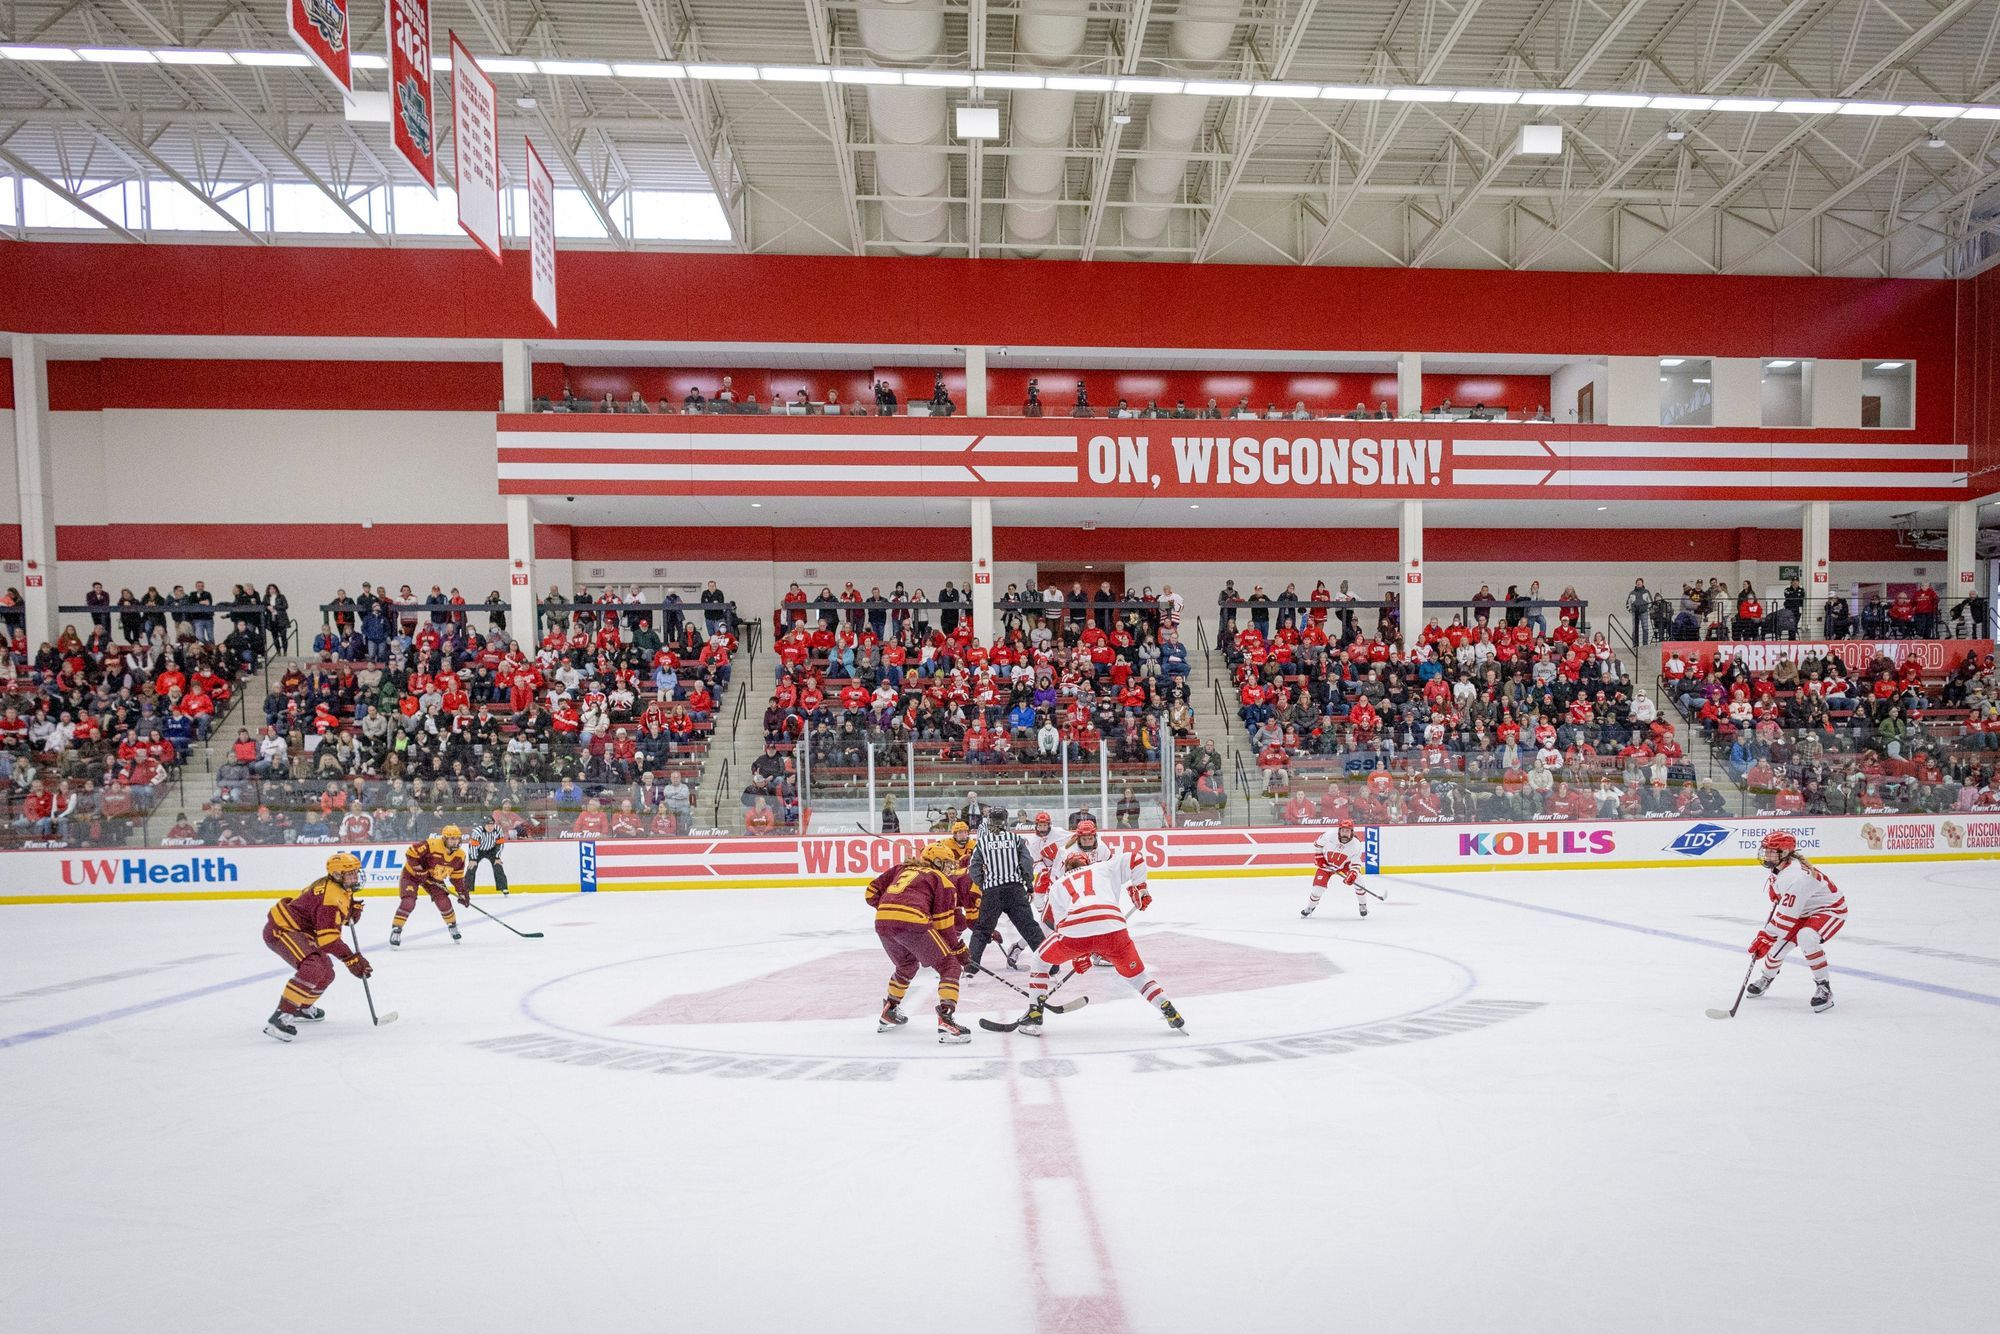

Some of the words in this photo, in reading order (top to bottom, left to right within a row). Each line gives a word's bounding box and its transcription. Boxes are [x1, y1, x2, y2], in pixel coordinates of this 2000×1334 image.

[396, 10, 428, 83] 2021
[1088, 436, 1161, 490] ON,
[1171, 437, 1443, 486] WISCONSIN!
[1742, 828, 1767, 837] FIBER
[1887, 824, 1935, 838] WISCONSIN
[1967, 823, 2000, 837] WISCON
[988, 840, 1015, 850] REINEN
[1366, 827, 1378, 867] CCM
[1459, 830, 1616, 856] KOHL'S
[1684, 832, 1716, 847] TDS
[1739, 840, 1757, 849] TDS
[1887, 838, 1935, 850] CRANBERRIES
[1967, 837, 2000, 848] CRANBER
[581, 842, 595, 884] CCM
[801, 838, 936, 874] WISCO
[60, 860, 119, 886] UW
[122, 857, 238, 884] Health
[1062, 869, 1096, 904] 17
[1782, 893, 1797, 908] 20
